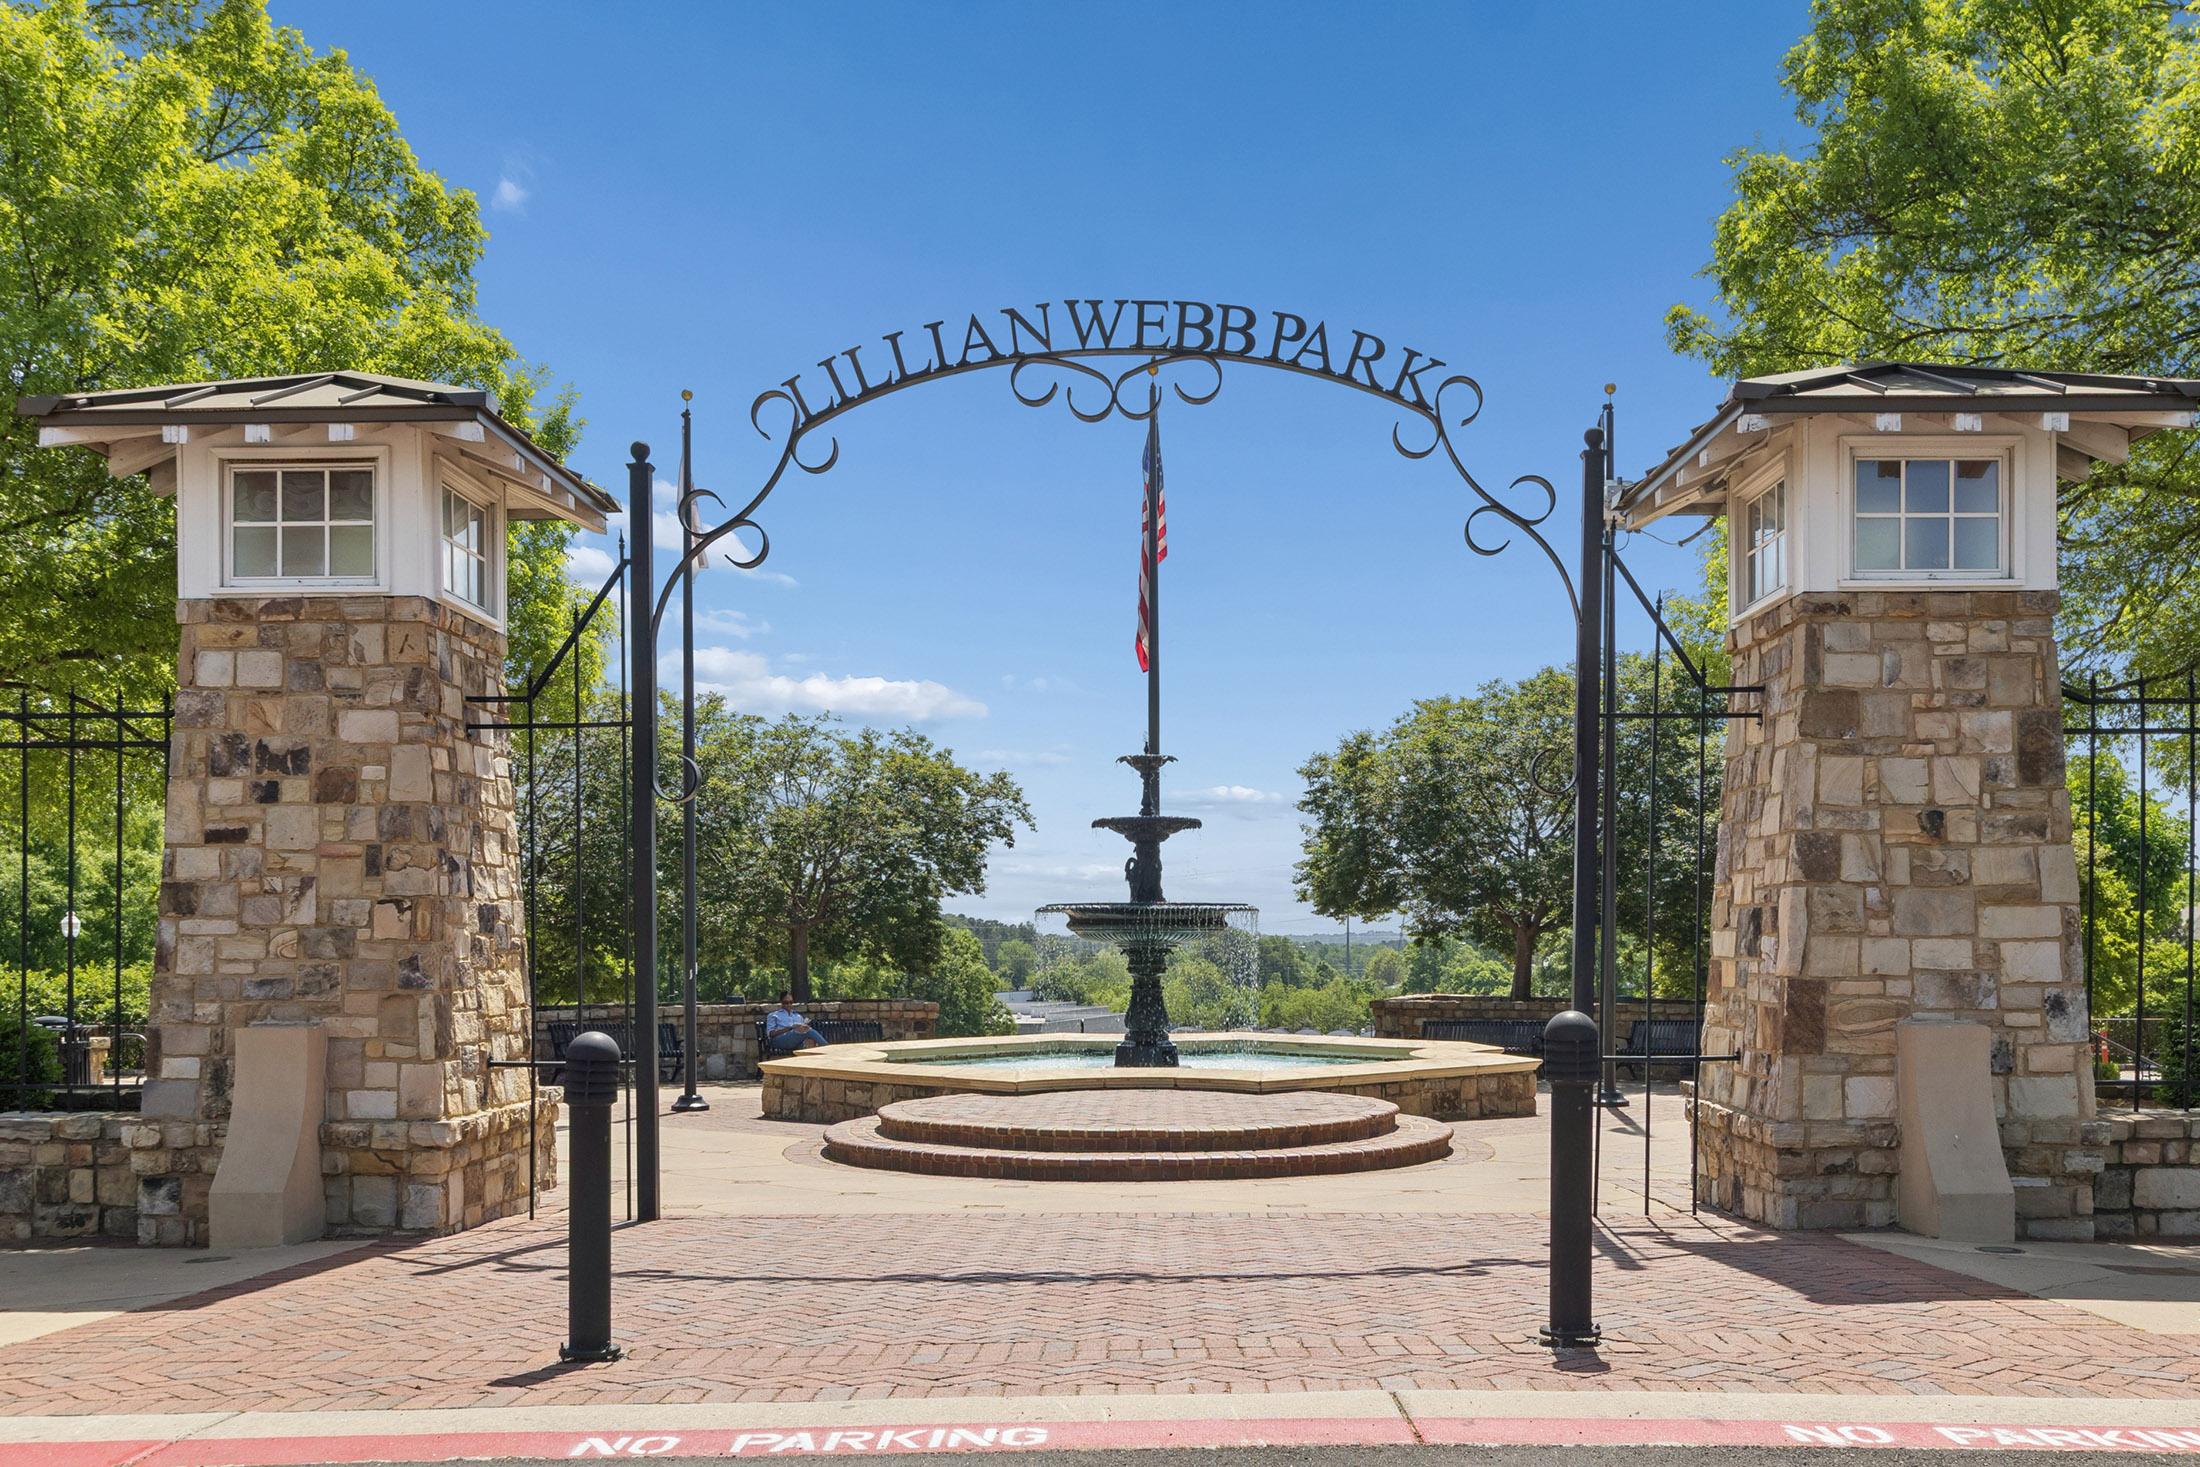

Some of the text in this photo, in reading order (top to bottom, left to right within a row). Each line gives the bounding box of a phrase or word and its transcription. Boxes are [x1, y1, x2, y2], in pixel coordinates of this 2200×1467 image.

[781, 300, 1446, 426] LILLIAN WEBB PARK
[569, 1428, 1048, 1456] NO PARKING
[1781, 1424, 1895, 1446] NO
